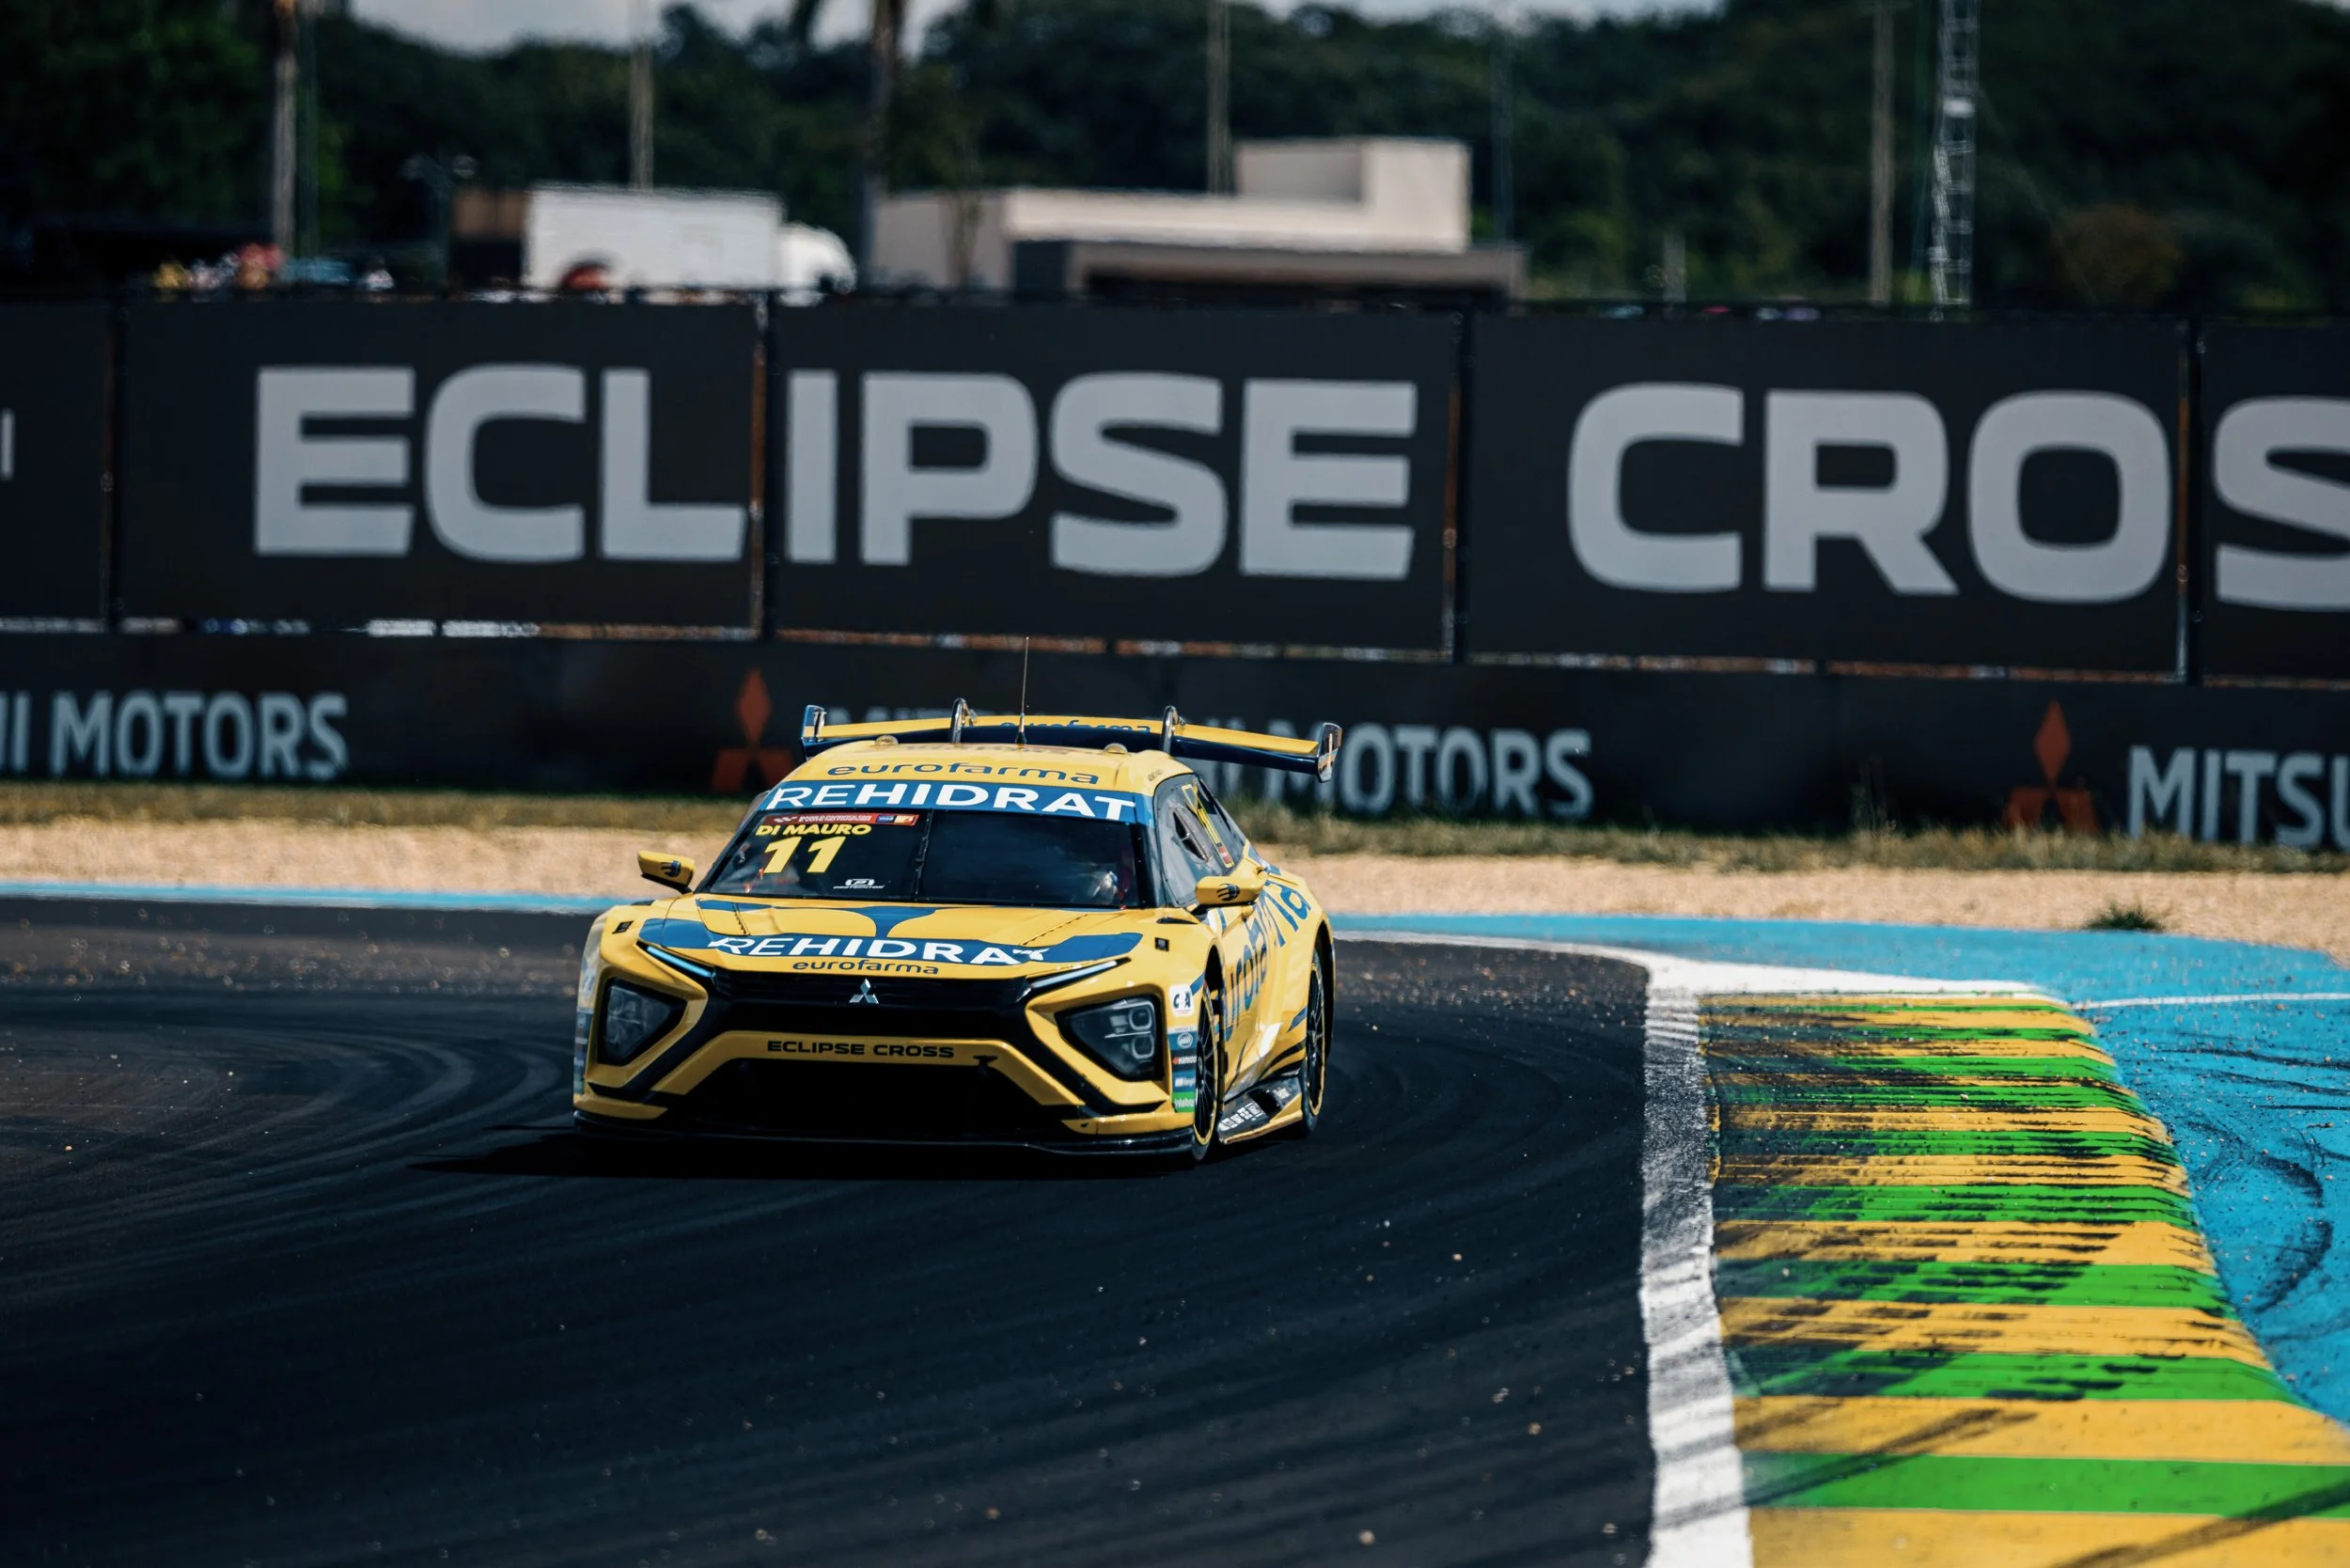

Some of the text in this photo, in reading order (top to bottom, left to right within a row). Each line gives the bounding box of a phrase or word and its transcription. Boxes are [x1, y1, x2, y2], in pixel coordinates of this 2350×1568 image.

[254, 362, 2350, 611] ECLIPSE CROS
[52, 689, 349, 779] MOTORS
[827, 761, 1100, 786] eurofarma
[766, 783, 1136, 823] REHIDRAT
[755, 823, 872, 836] DI MAURO
[762, 836, 847, 873] 11
[792, 959, 939, 975] eurofarma
[767, 1040, 955, 1059] ECLIPSE CROSS
